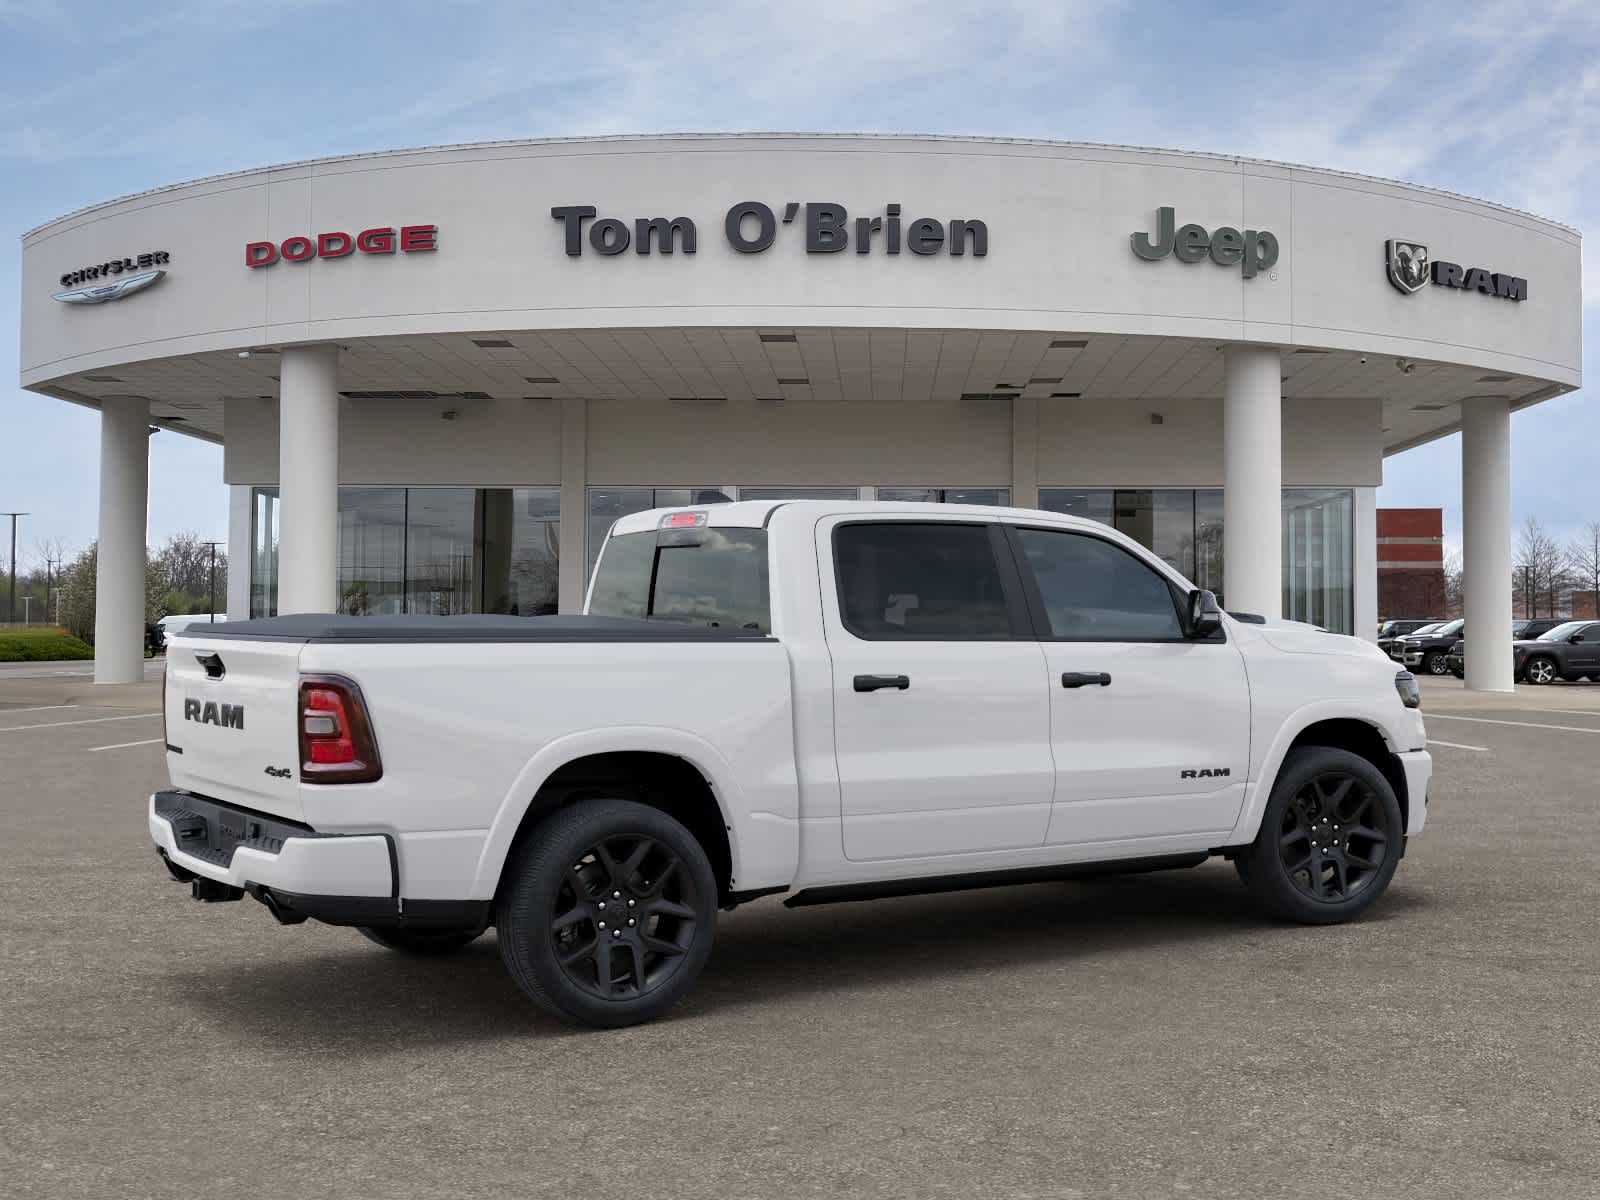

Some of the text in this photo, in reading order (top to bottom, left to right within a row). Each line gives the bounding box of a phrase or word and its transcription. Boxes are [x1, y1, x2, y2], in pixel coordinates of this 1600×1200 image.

[245, 225, 438, 269] DODGE
[551, 201, 988, 257] Tom O'Brien
[1130, 206, 1279, 278] Jeep
[60, 250, 170, 287] CHRYSLER
[1431, 260, 1528, 301] RAM
[184, 698, 244, 729] RAM
[1180, 767, 1231, 779] RAM
